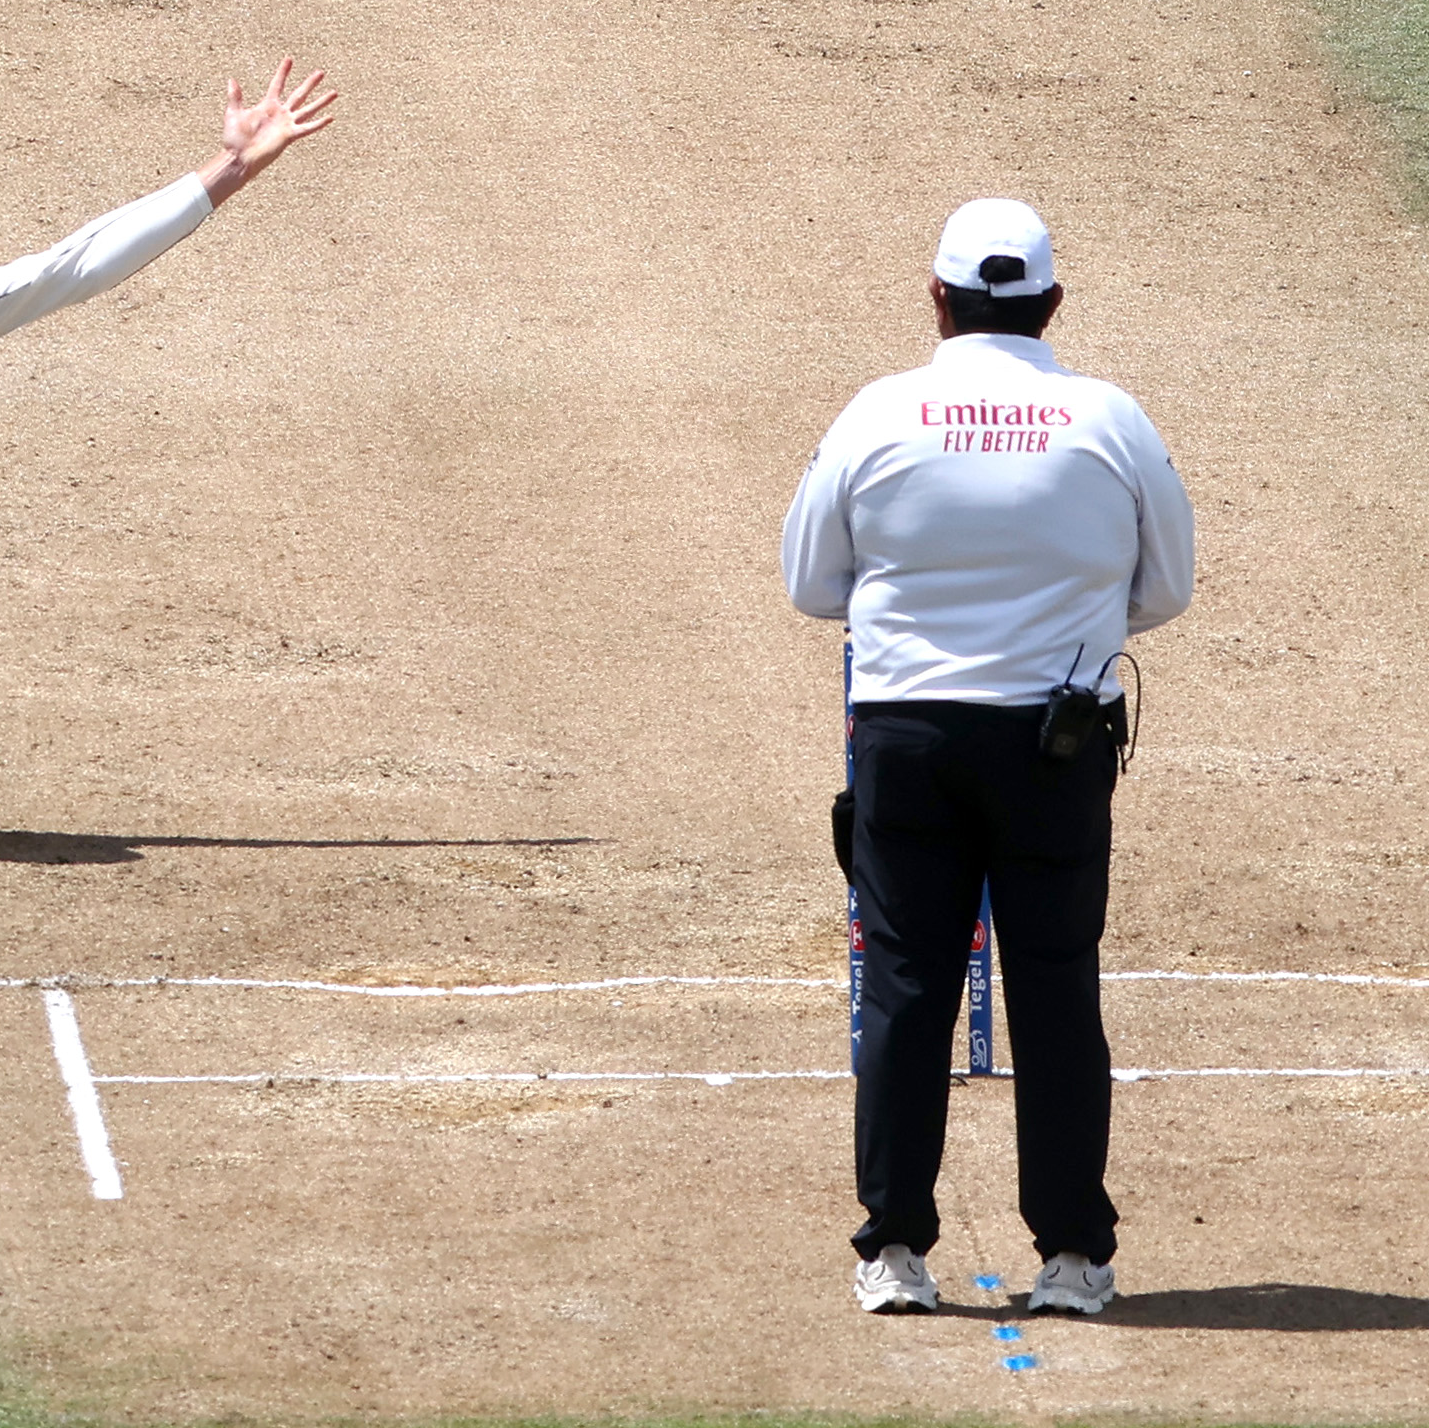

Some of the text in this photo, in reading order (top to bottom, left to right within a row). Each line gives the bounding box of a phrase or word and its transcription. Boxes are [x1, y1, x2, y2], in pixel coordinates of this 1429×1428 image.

[921, 398, 1072, 426] Emirates
[943, 430, 1050, 452] FLY BETTER
[969, 960, 987, 1014] Tegel
